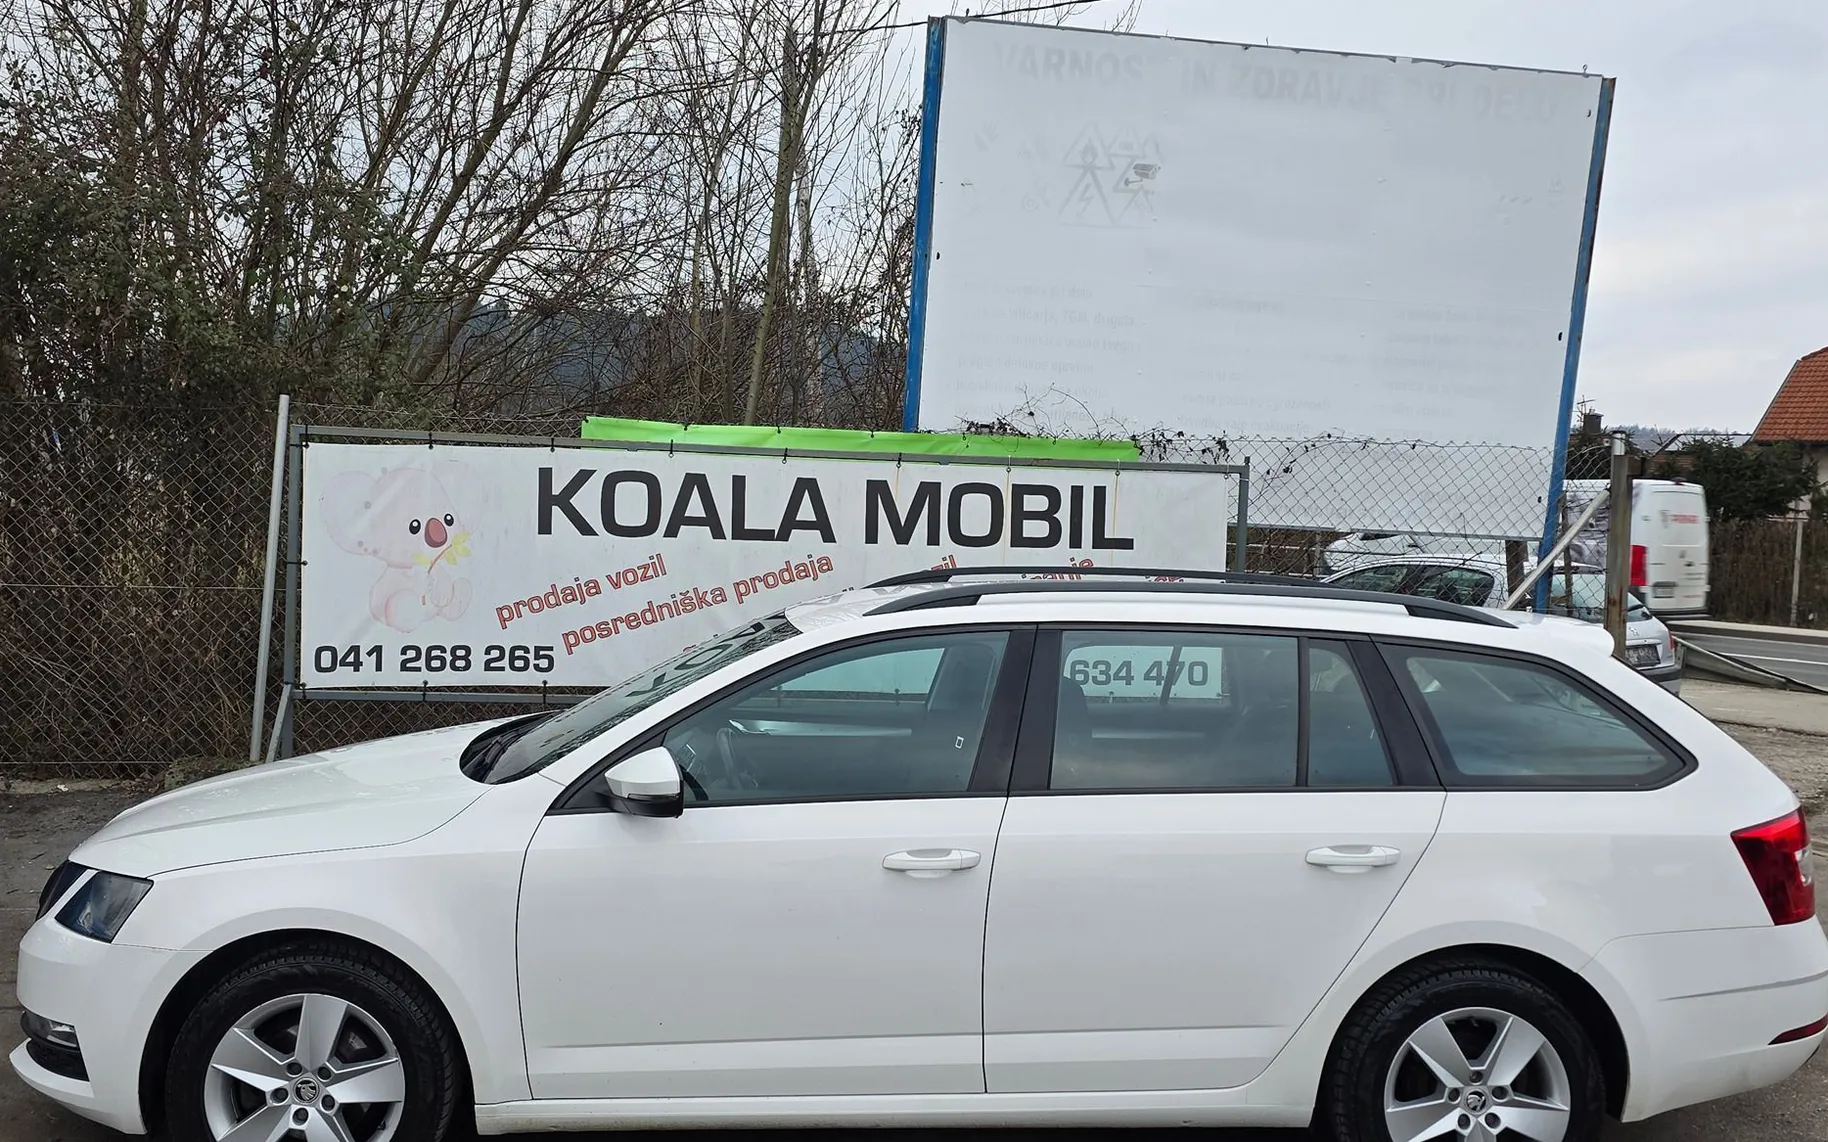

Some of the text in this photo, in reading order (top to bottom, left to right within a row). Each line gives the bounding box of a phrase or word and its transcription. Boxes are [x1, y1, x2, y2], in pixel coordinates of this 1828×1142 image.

[537, 467, 1134, 550] KOALA MOBIL
[495, 553, 667, 630] prodaja vozil
[561, 553, 834, 655] posredniška prodaja
[313, 644, 555, 673] 041 268 265
[1070, 660, 1209, 687] 634 470
